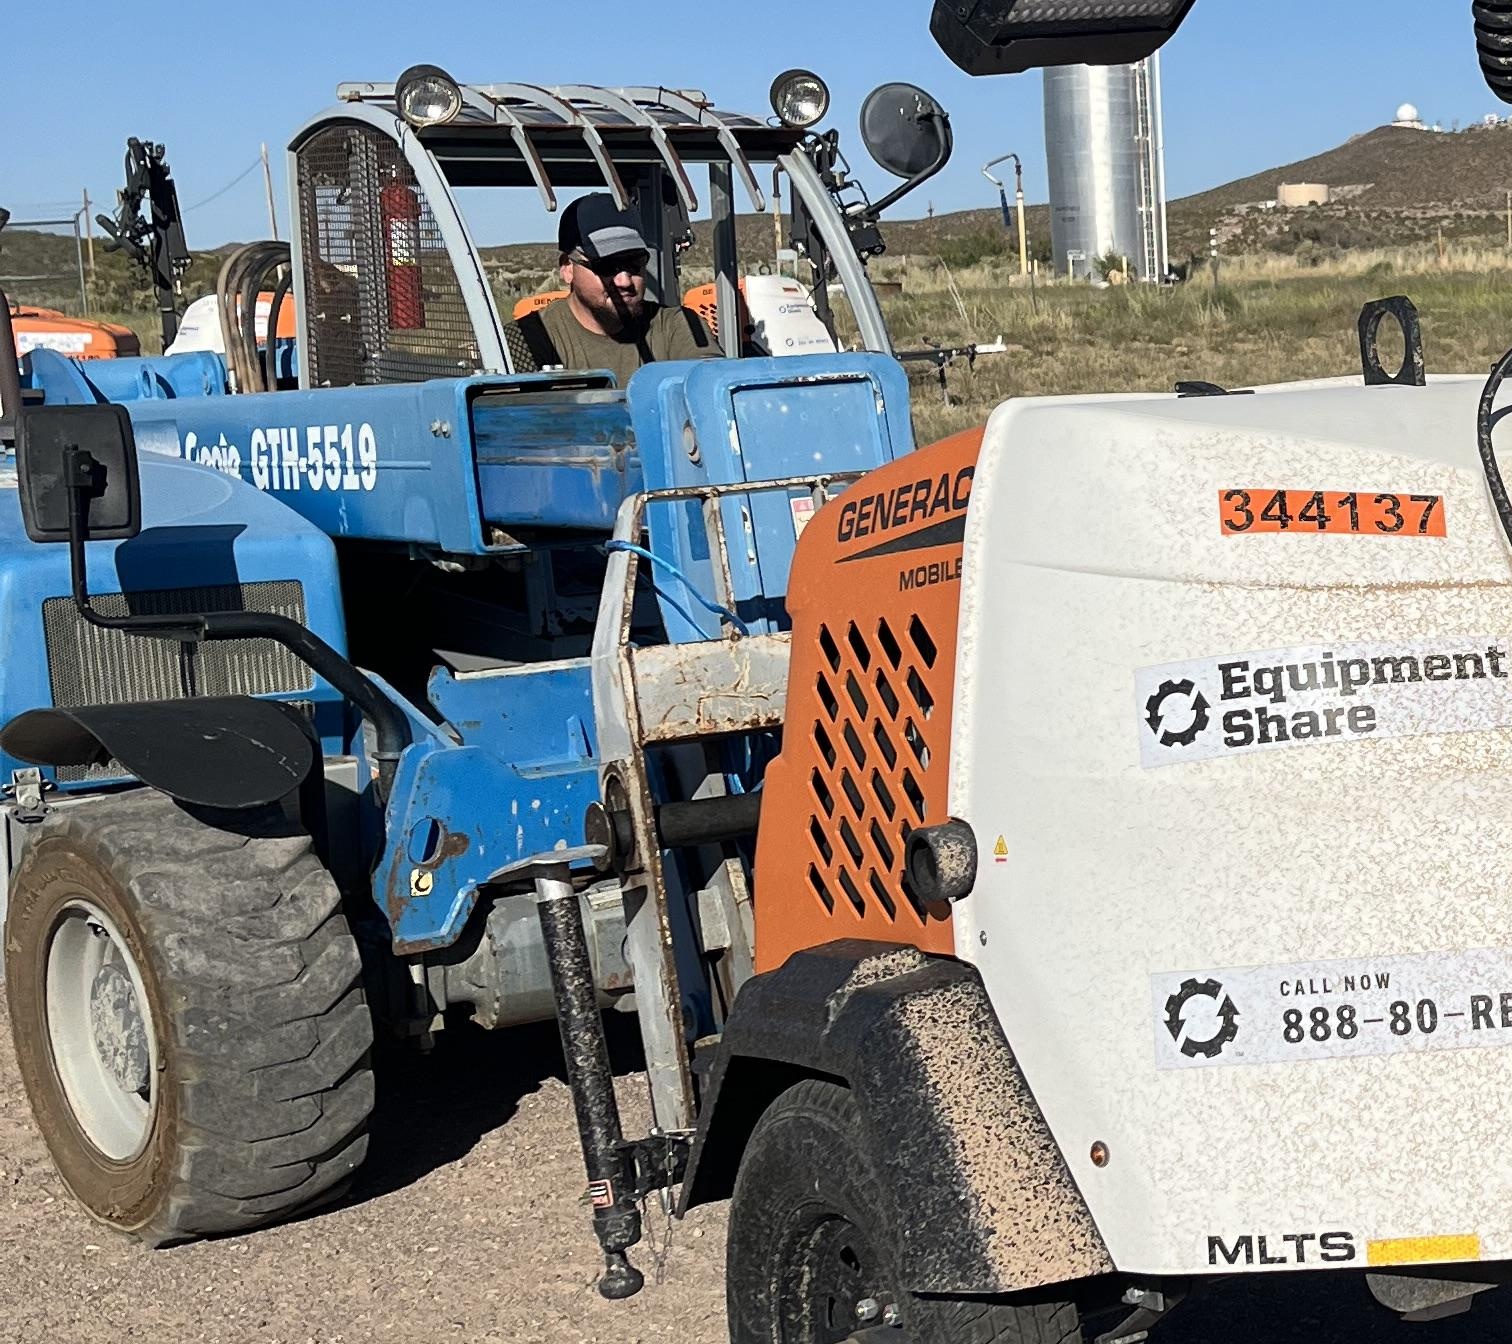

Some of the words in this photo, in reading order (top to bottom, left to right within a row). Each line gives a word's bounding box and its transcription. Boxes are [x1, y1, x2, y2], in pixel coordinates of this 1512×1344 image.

[251, 423, 377, 491] GTH-5519
[838, 465, 976, 543] GENERAC
[1223, 489, 1439, 534] 344137
[1217, 645, 1509, 704] Equipment
[1223, 704, 1378, 749] Share
[1279, 978, 1333, 997] CALL
[1344, 972, 1391, 993] NOW
[1207, 1231, 1356, 1265] MLTS
